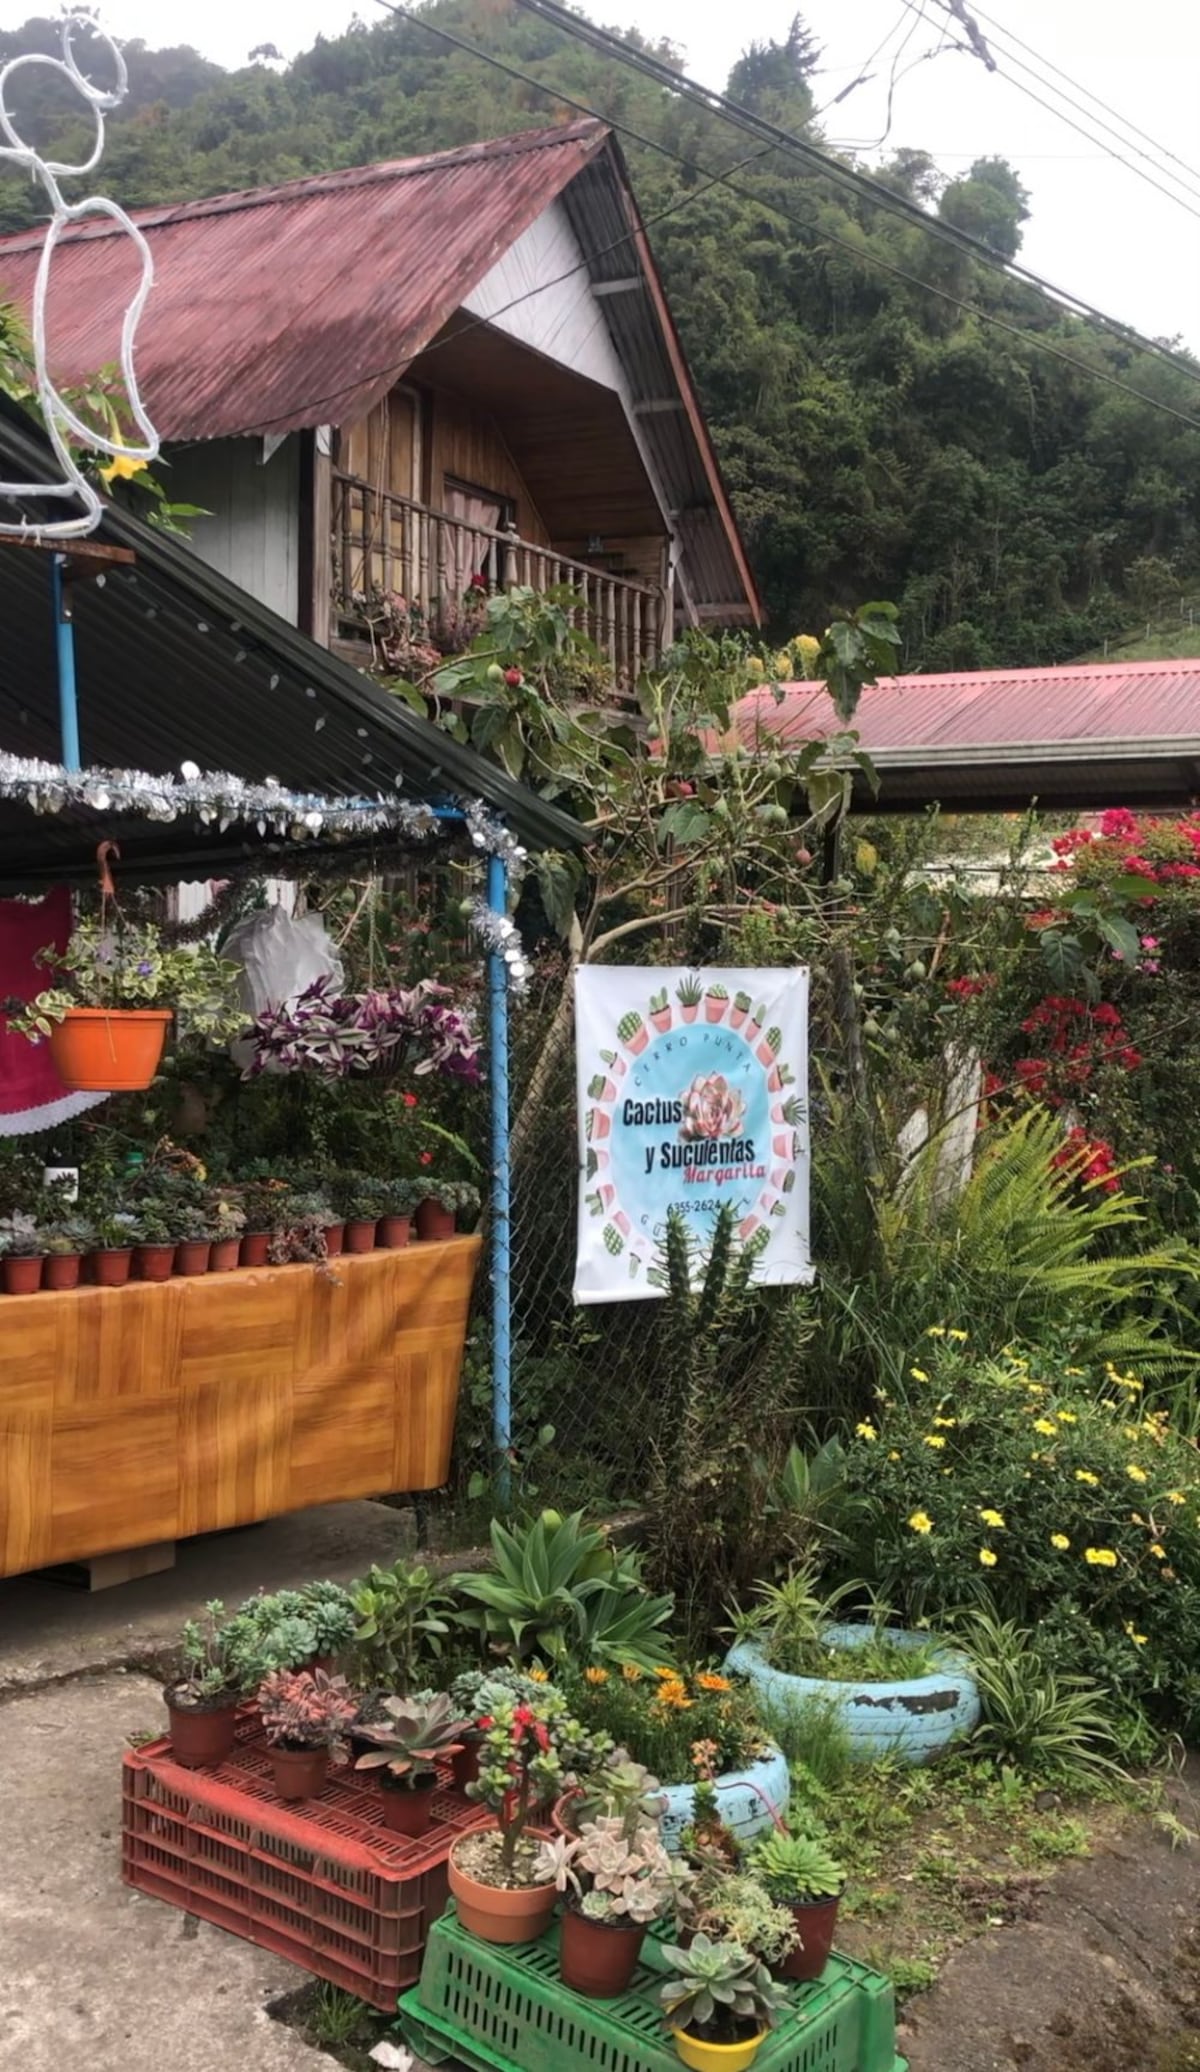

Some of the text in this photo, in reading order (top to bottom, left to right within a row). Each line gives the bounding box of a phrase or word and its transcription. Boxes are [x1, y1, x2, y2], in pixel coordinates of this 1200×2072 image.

[622, 1098, 682, 1127] Cactus
[645, 1138, 755, 1175] y Suculentas
[683, 1163, 766, 1186] Margarita
